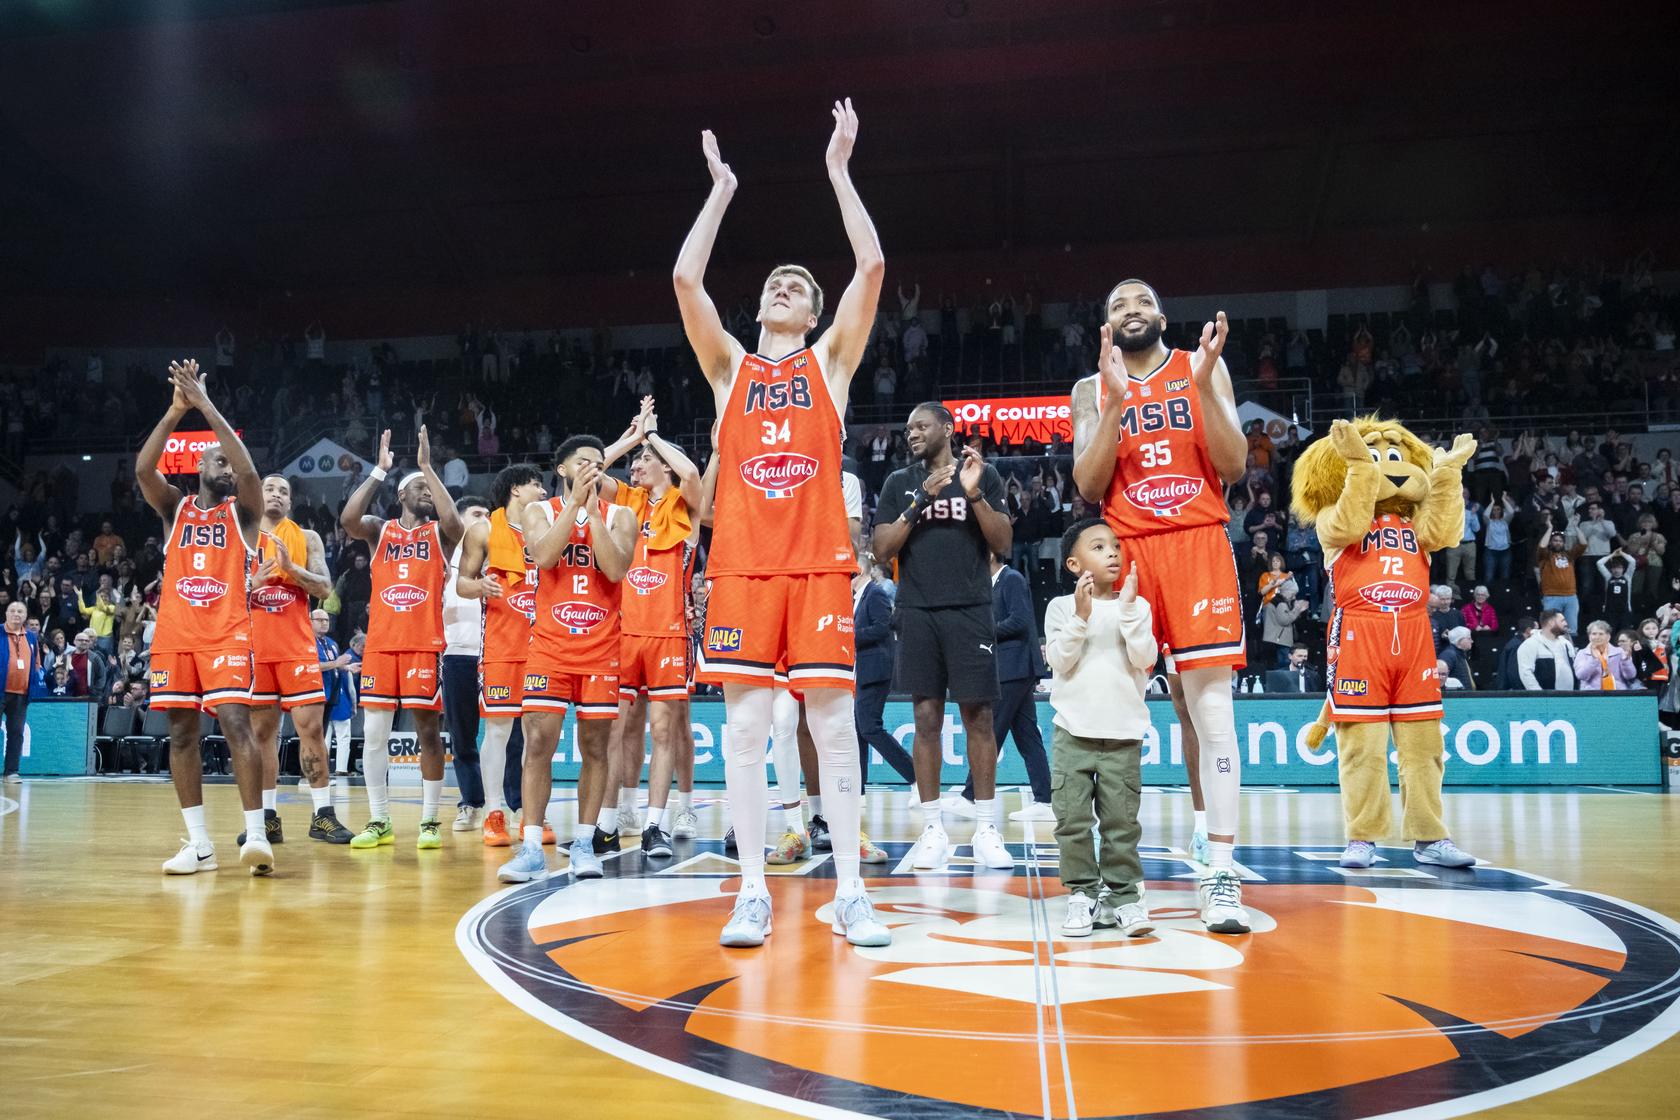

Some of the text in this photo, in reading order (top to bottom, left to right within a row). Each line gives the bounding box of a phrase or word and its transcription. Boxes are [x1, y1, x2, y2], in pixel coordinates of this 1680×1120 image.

[745, 374, 813, 415] MSB
[996, 405, 1071, 420] course
[761, 419, 790, 445] 34
[1001, 419, 1071, 440] MANS
[1140, 440, 1172, 468] 35
[753, 460, 813, 483] Gaulois
[1137, 481, 1198, 504] Gaulois
[1361, 527, 1418, 554] MSB
[193, 553, 206, 570] 8
[384, 541, 430, 563] MSB
[398, 564, 409, 579] 5
[1379, 556, 1404, 576] 72
[183, 580, 224, 595] Gaulois
[572, 575, 589, 595] 12
[1371, 585, 1419, 601] Gaulois
[388, 589, 424, 602] Gaulois
[560, 605, 604, 622] Gaulois
[487, 687, 509, 698] Loué
[1338, 681, 1366, 693] Loué
